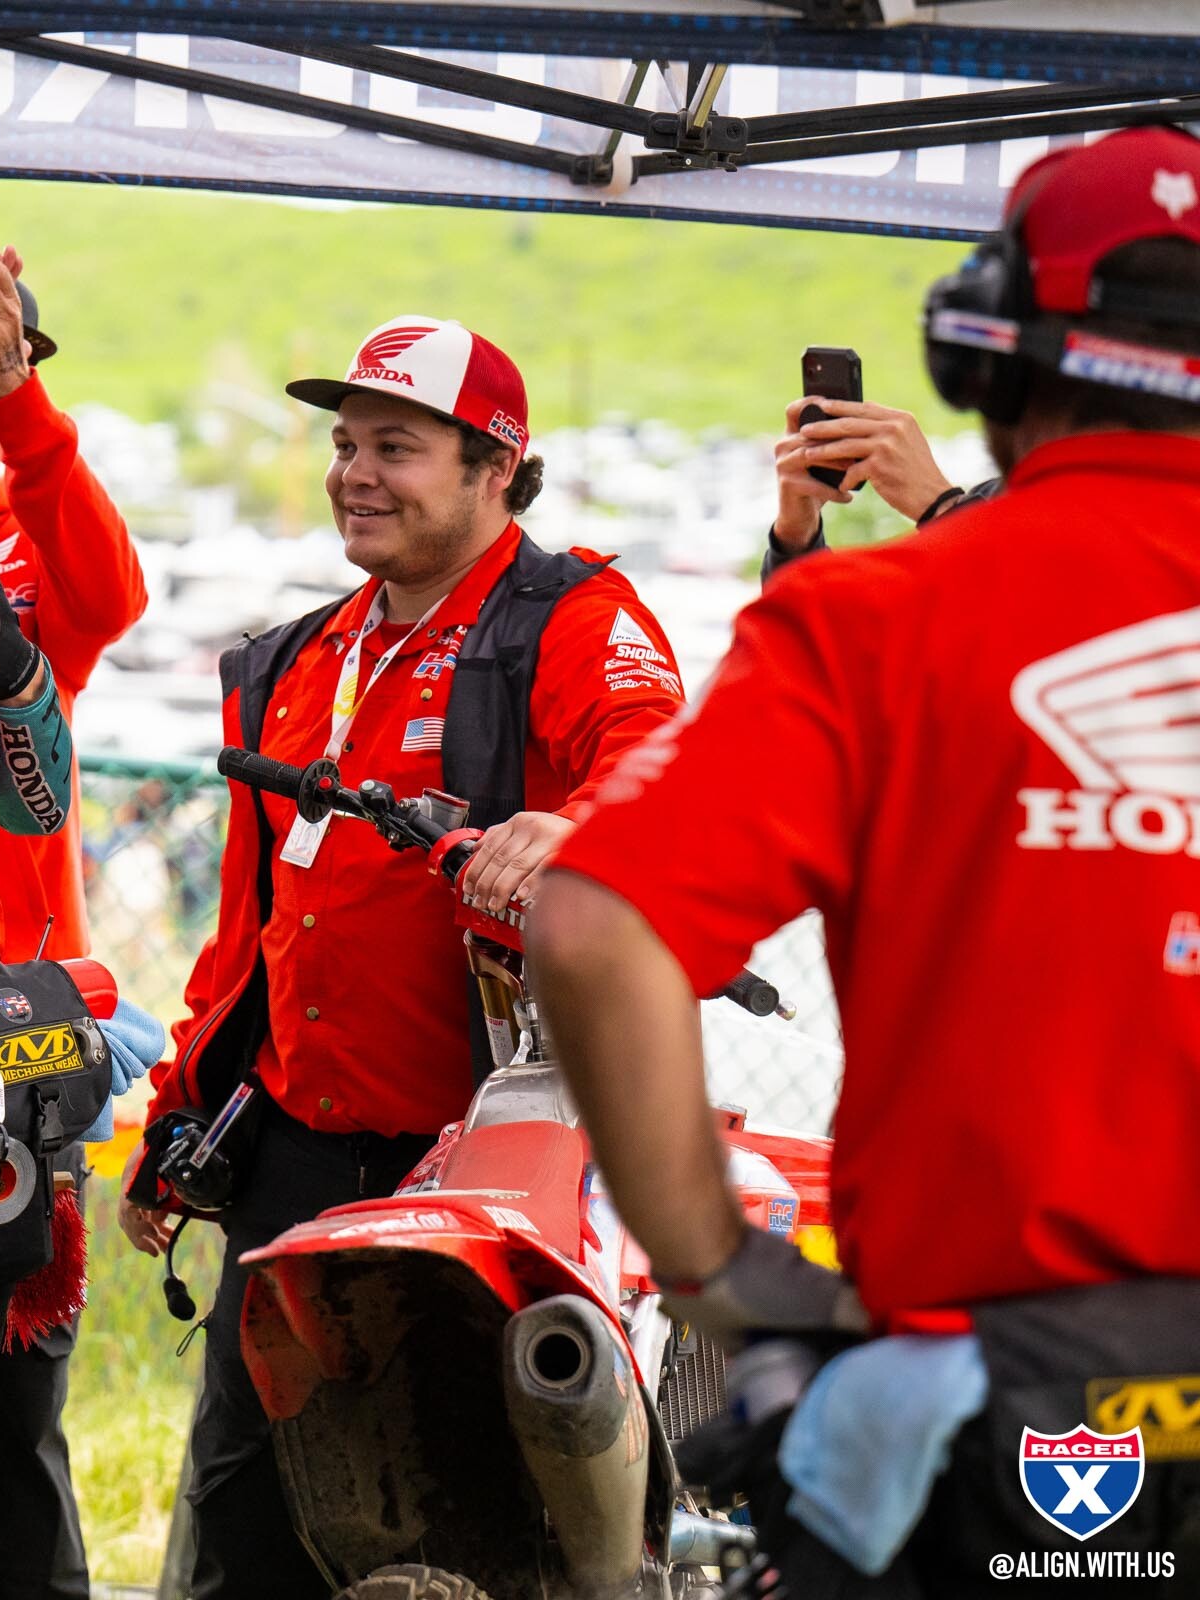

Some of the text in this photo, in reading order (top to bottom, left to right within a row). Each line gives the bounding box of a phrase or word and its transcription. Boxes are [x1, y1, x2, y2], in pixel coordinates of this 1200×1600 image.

[347, 367, 415, 387] HONDA
[0, 720, 65, 835] HONDA
[0, 1055, 81, 1081] MECHANIX WEAR
